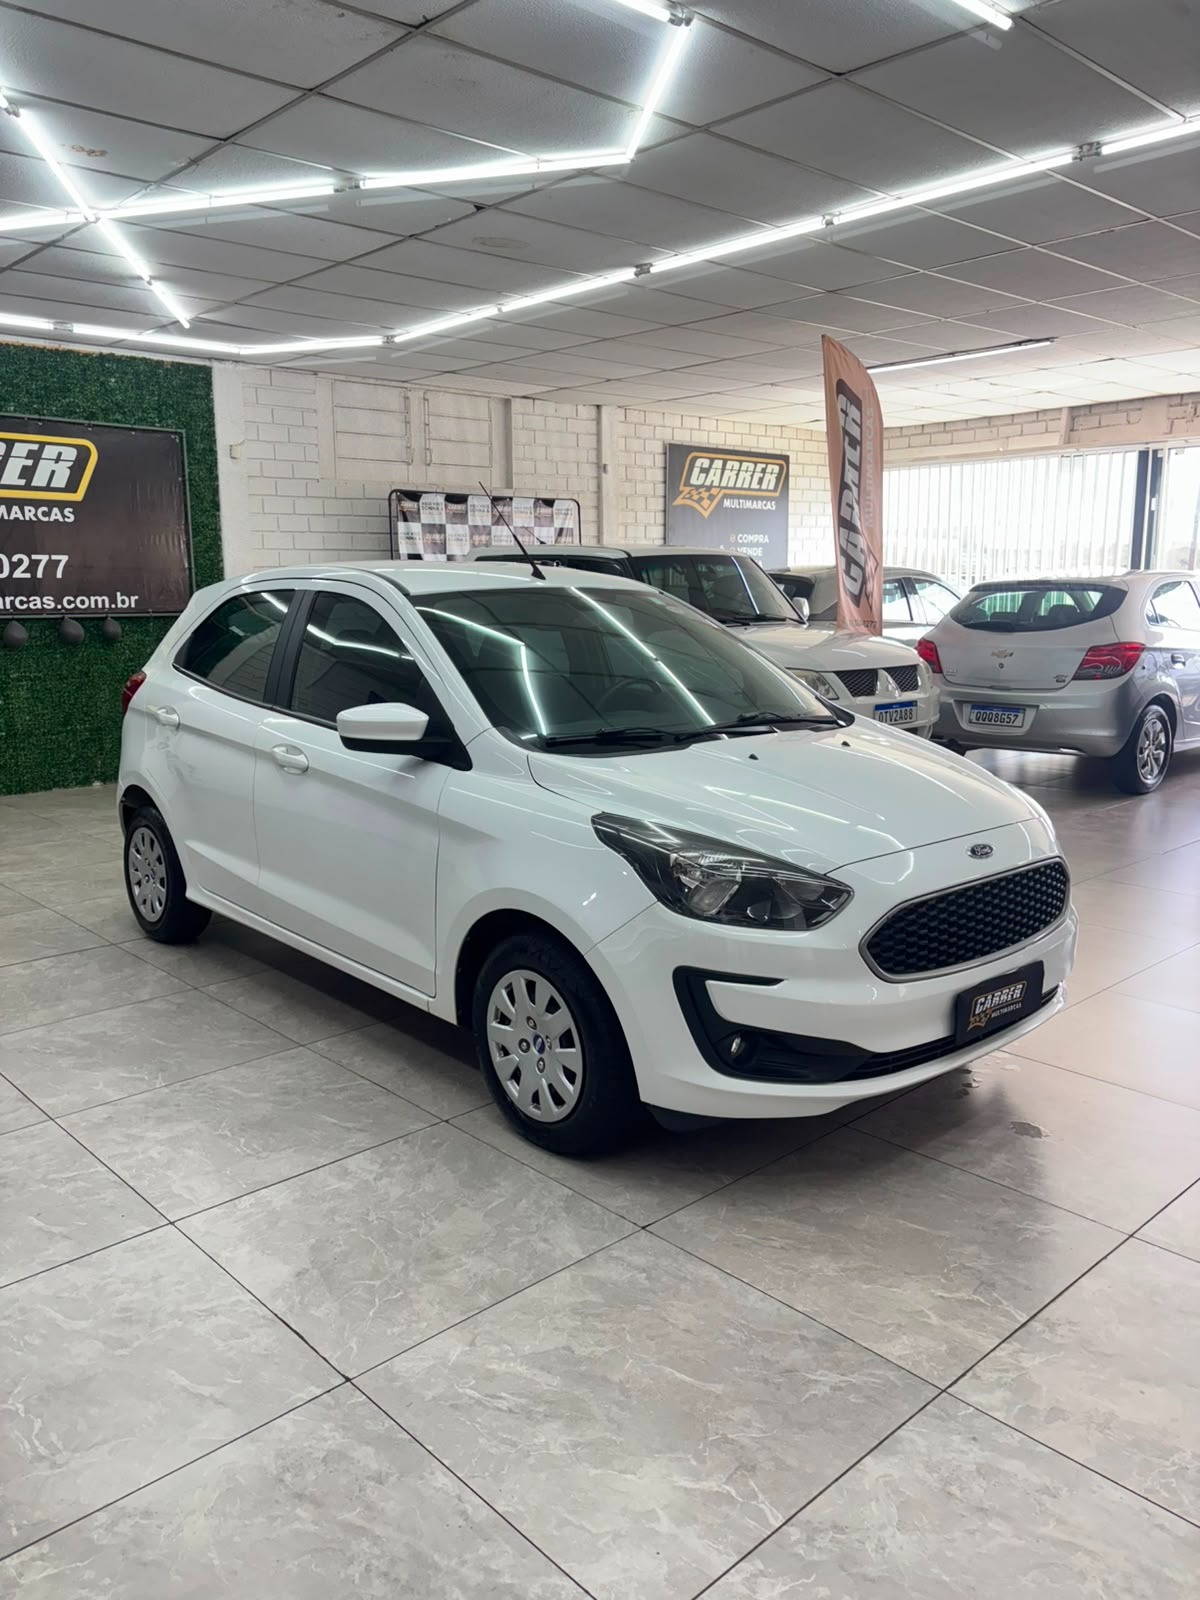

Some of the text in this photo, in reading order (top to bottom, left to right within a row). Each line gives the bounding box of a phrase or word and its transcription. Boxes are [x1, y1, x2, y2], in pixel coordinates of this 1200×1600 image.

[0, 442, 78, 488] ER
[689, 457, 780, 490] CARRER
[723, 498, 776, 511] MULTIMARCAS
[737, 533, 769, 543] COMPRA
[975, 984, 1023, 1015] CARRER
